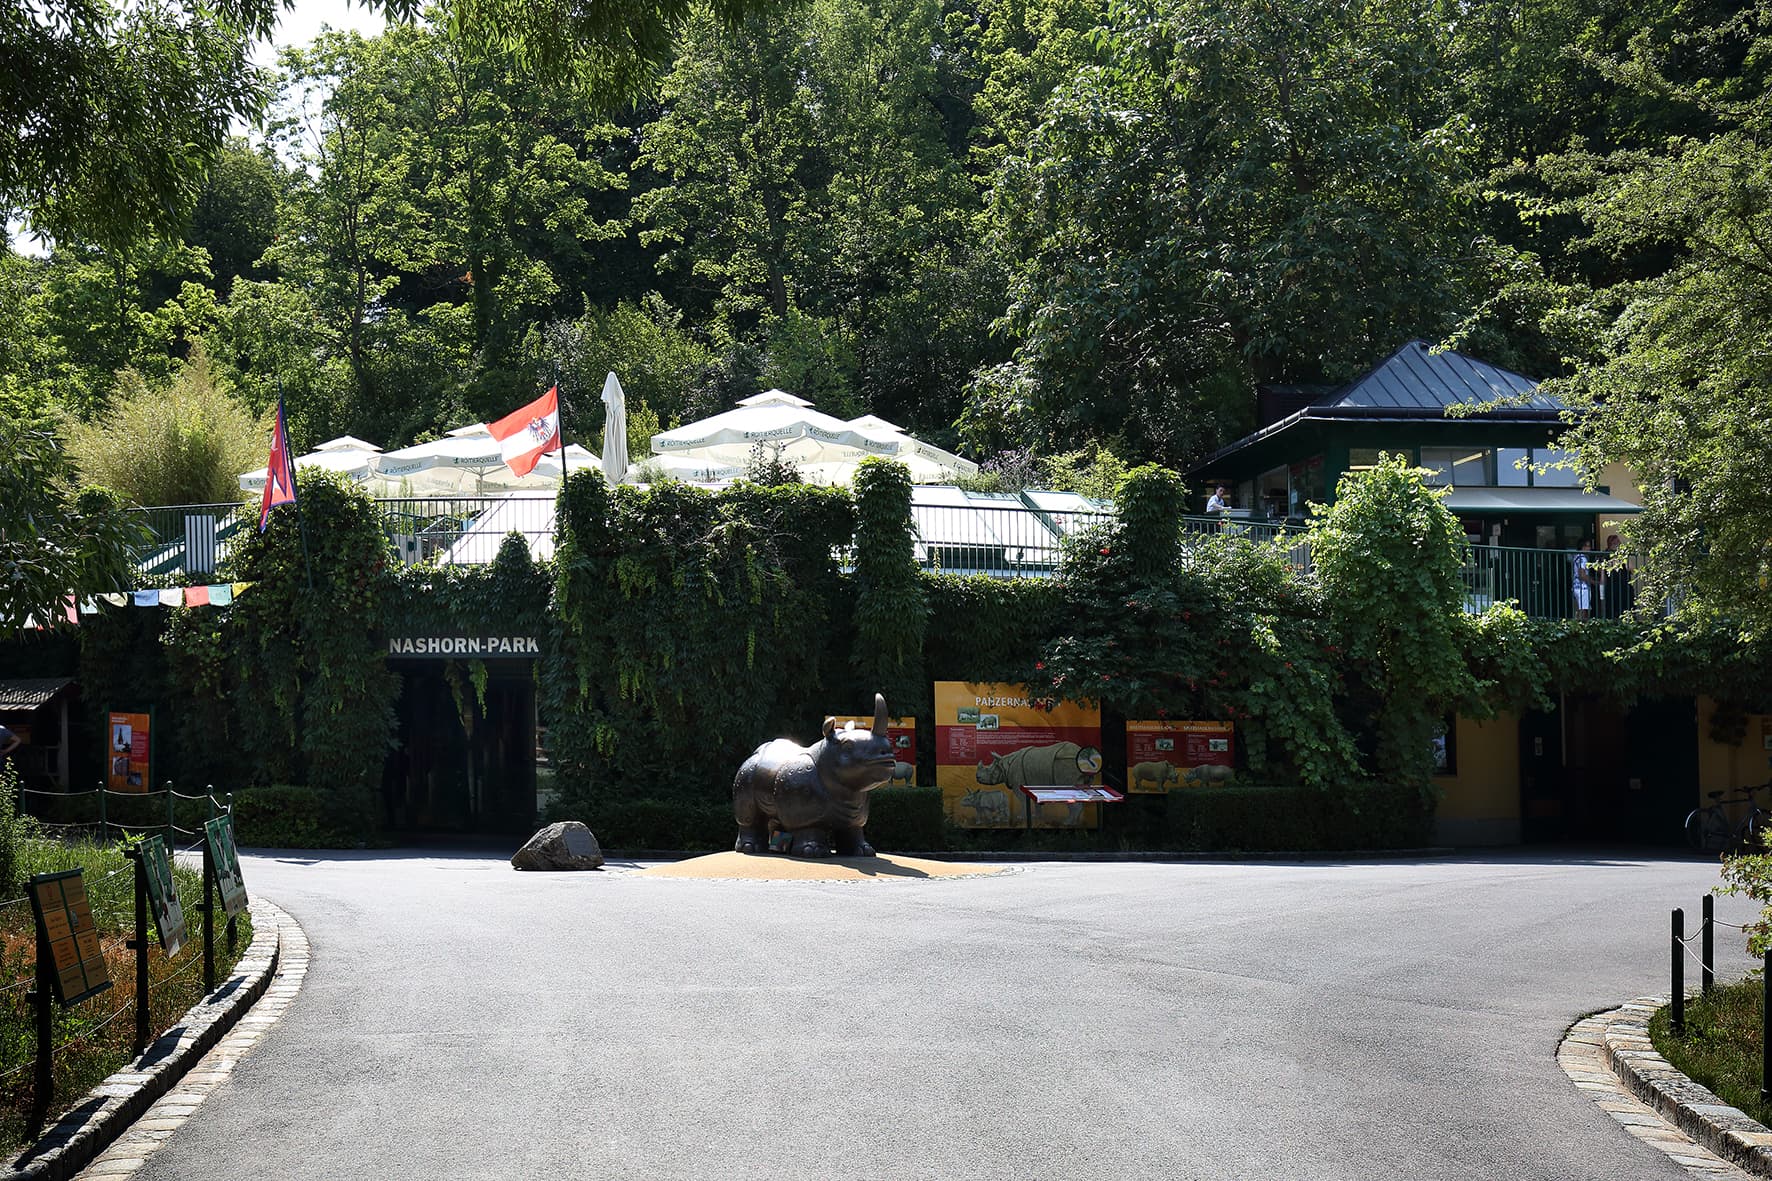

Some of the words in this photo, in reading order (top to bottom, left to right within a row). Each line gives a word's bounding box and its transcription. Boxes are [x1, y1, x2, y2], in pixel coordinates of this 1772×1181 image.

[750, 427, 793, 438] RÖMERQUELLE
[667, 438, 705, 447] RÖMERQUELLE
[460, 455, 499, 464] RÖMERQUELLE
[389, 637, 539, 653] NASHORN-PARK
